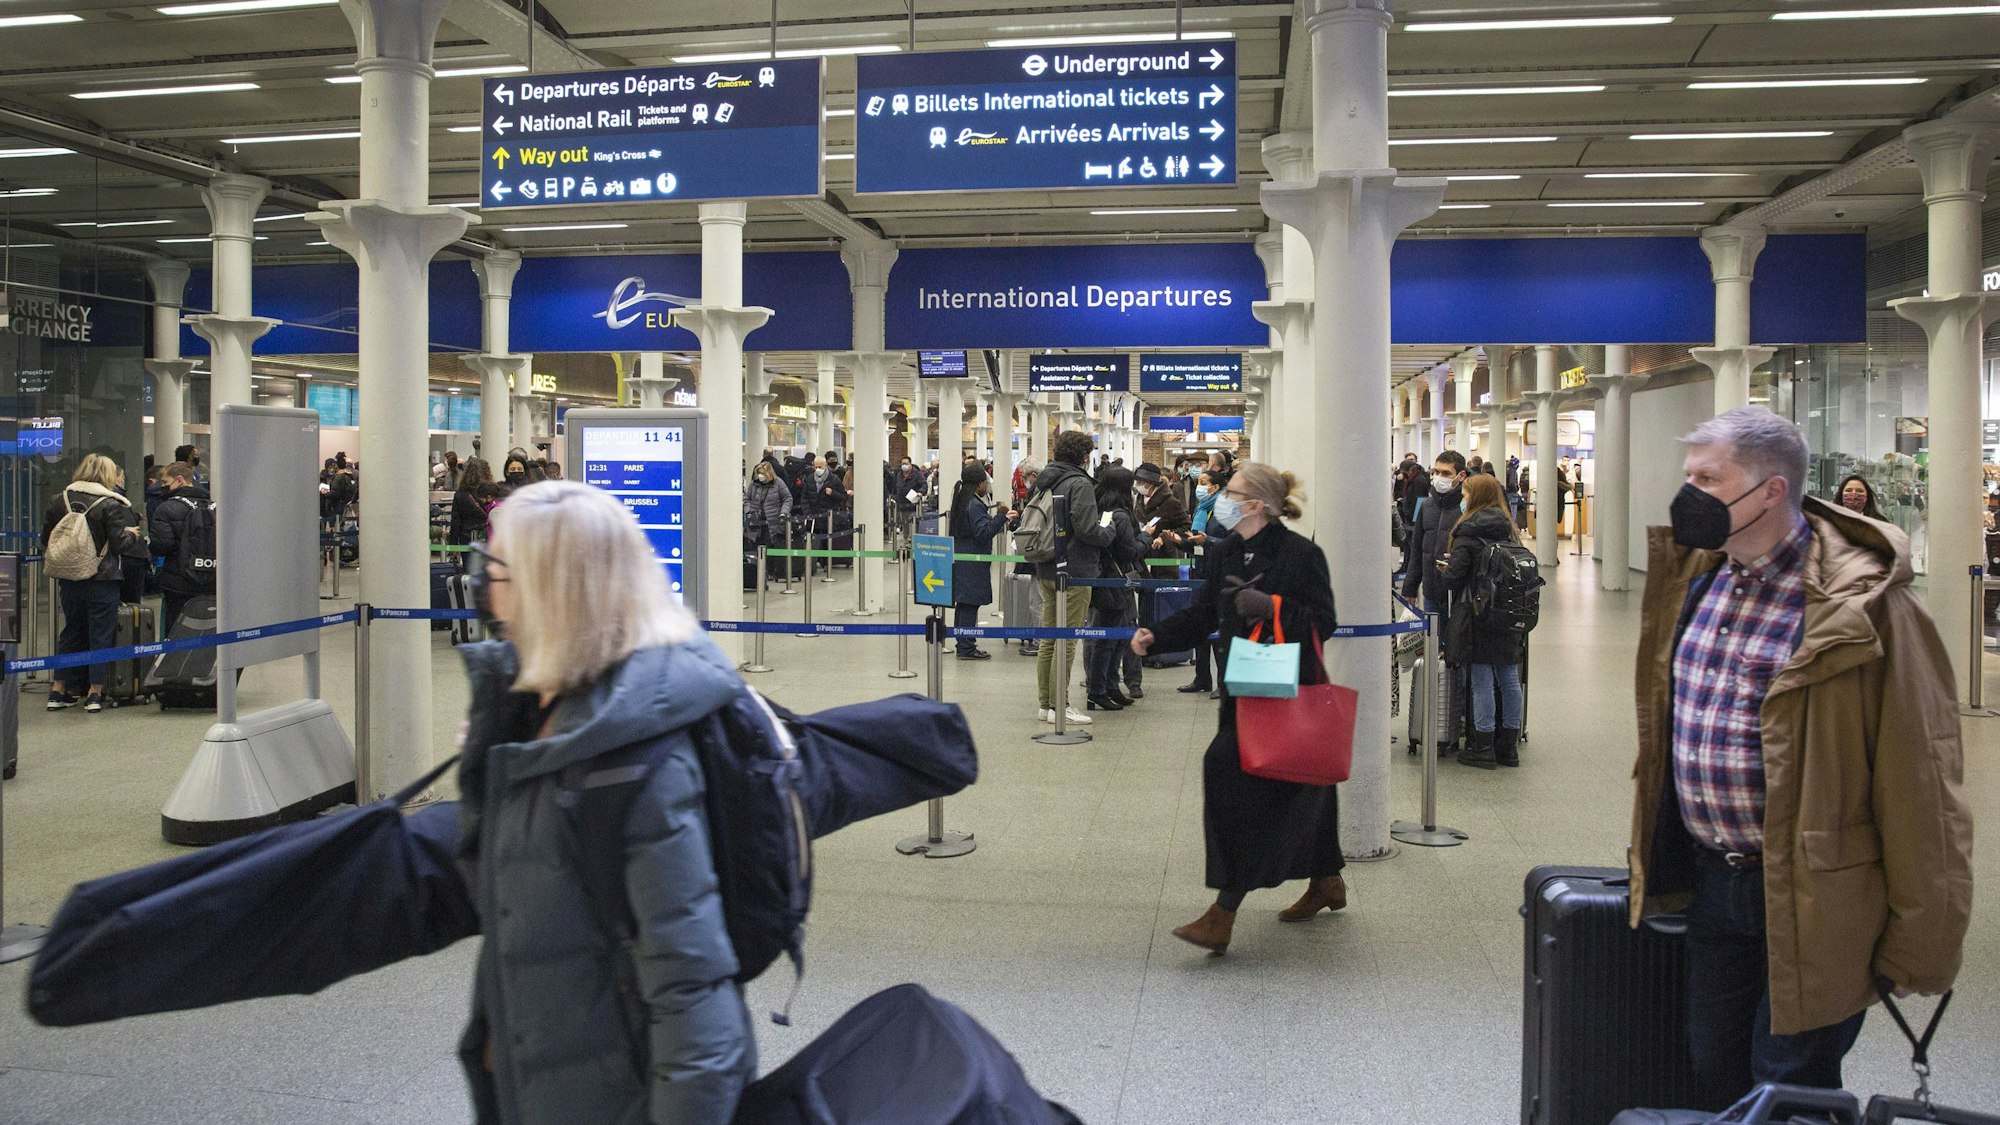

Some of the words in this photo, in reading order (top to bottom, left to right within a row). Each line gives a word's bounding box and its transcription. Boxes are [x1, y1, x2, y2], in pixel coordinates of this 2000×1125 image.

[1053, 51, 1190, 76] Underground
[520, 79, 619, 103] Departures
[624, 74, 696, 99] Départs
[914, 93, 979, 113] Billets
[984, 89, 1117, 111] International
[1120, 87, 1190, 107] tickets
[520, 111, 593, 133] National
[597, 109, 633, 129] Rail
[637, 105, 668, 116] Tickets
[669, 104, 687, 115] and
[637, 115, 680, 128] platforms
[1015, 123, 1102, 145] Arrivées
[1106, 121, 1190, 142] Arrivals
[519, 147, 556, 168] Way
[560, 145, 589, 164] out
[593, 150, 620, 163] King's
[622, 149, 647, 161] Cross
[1983, 271, 2000, 292] FO
[918, 285, 1079, 310] International
[1086, 284, 1233, 313] Departures
[8, 298, 92, 323] RRENCY
[645, 312, 678, 328] EU
[1040, 365, 1070, 373] Departures
[623, 464, 645, 472] PARIS
[623, 498, 659, 506] BRUSSELS
